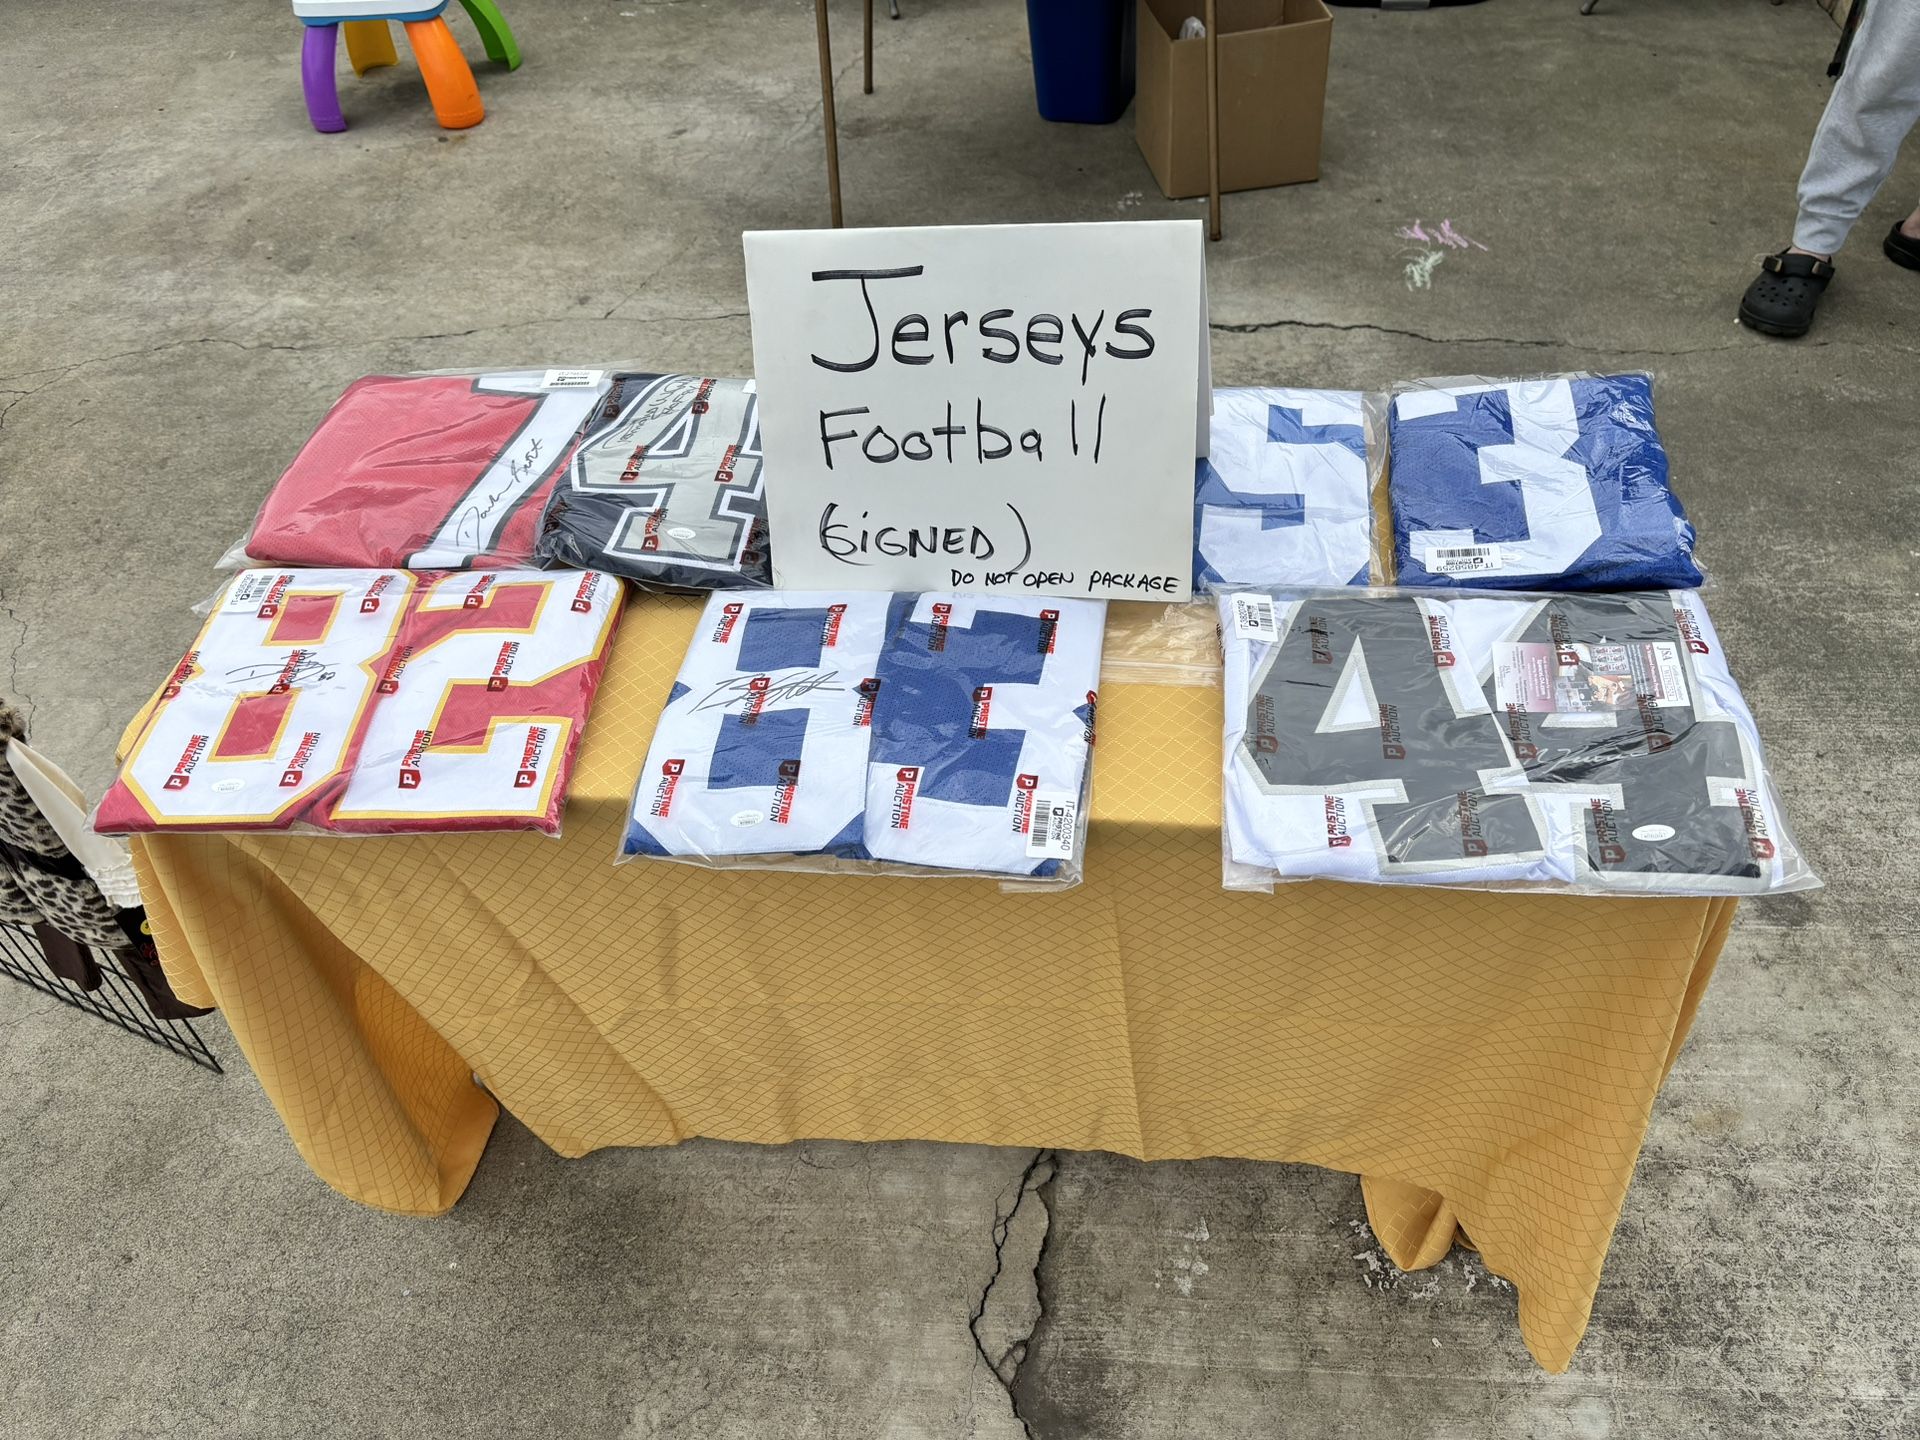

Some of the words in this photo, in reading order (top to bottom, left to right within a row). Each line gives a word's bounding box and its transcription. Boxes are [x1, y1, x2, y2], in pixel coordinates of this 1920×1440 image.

[812, 265, 1154, 385] Jerseys
[819, 393, 1105, 470] Football
[576, 570, 594, 599] PRISTINE
[585, 572, 601, 599] AUCTION
[951, 569, 974, 586] DO
[985, 571, 1019, 586] NOT
[1023, 571, 1074, 588] OPEN
[1088, 570, 1180, 593] PACKAGE
[712, 615, 727, 642] AUCTION
[720, 614, 738, 643] PRISTINE
[827, 613, 842, 646] PRISTINE
[1428, 615, 1441, 650] PRISTINE
[1439, 616, 1450, 649] AUCTION
[1673, 609, 1693, 639] PRISTINE
[1683, 609, 1700, 640] AUCTION
[384, 645, 404, 679] PRISTINE
[393, 646, 413, 679] AUCTION
[492, 641, 512, 675] PRISTINE
[502, 642, 520, 675] AUCTION
[853, 694, 868, 725] AUCTION
[860, 693, 876, 726] PRISTINE
[968, 703, 981, 738] AUCTION
[976, 702, 990, 739] PRISTINE
[1256, 694, 1265, 734] PRISTINE
[1265, 696, 1274, 734] AUCTION
[1379, 704, 1392, 743] PRISTINE
[1388, 705, 1400, 742] AUCTION
[1516, 703, 1531, 741] AUCTION
[174, 735, 201, 773] PRISTINE
[184, 735, 209, 773] AUCTION
[288, 732, 313, 768] PRISTINE
[298, 732, 321, 768] AUCTION
[402, 730, 425, 767] PRISTINE
[412, 730, 432, 767] AUCTION
[520, 726, 539, 768] PRISTINE
[530, 728, 547, 768] AUCTION
[651, 777, 668, 815] AUCTION
[659, 776, 678, 817] PRISTINE
[770, 777, 787, 822] AUCTION
[778, 776, 795, 823] PRISTINE
[891, 783, 905, 828] AUCTION
[900, 782, 915, 829] PRISTINE
[1012, 790, 1026, 832] AUCTION
[1467, 792, 1481, 837] AUCTION
[1747, 790, 1768, 836] AUCTION
[1060, 800, 1076, 851] IT-4200340
[1325, 795, 1337, 835] PRISTINE
[1336, 797, 1346, 834] AUCTION
[1591, 798, 1608, 843] PRISTINE
[1602, 799, 1618, 843] AUCTION
